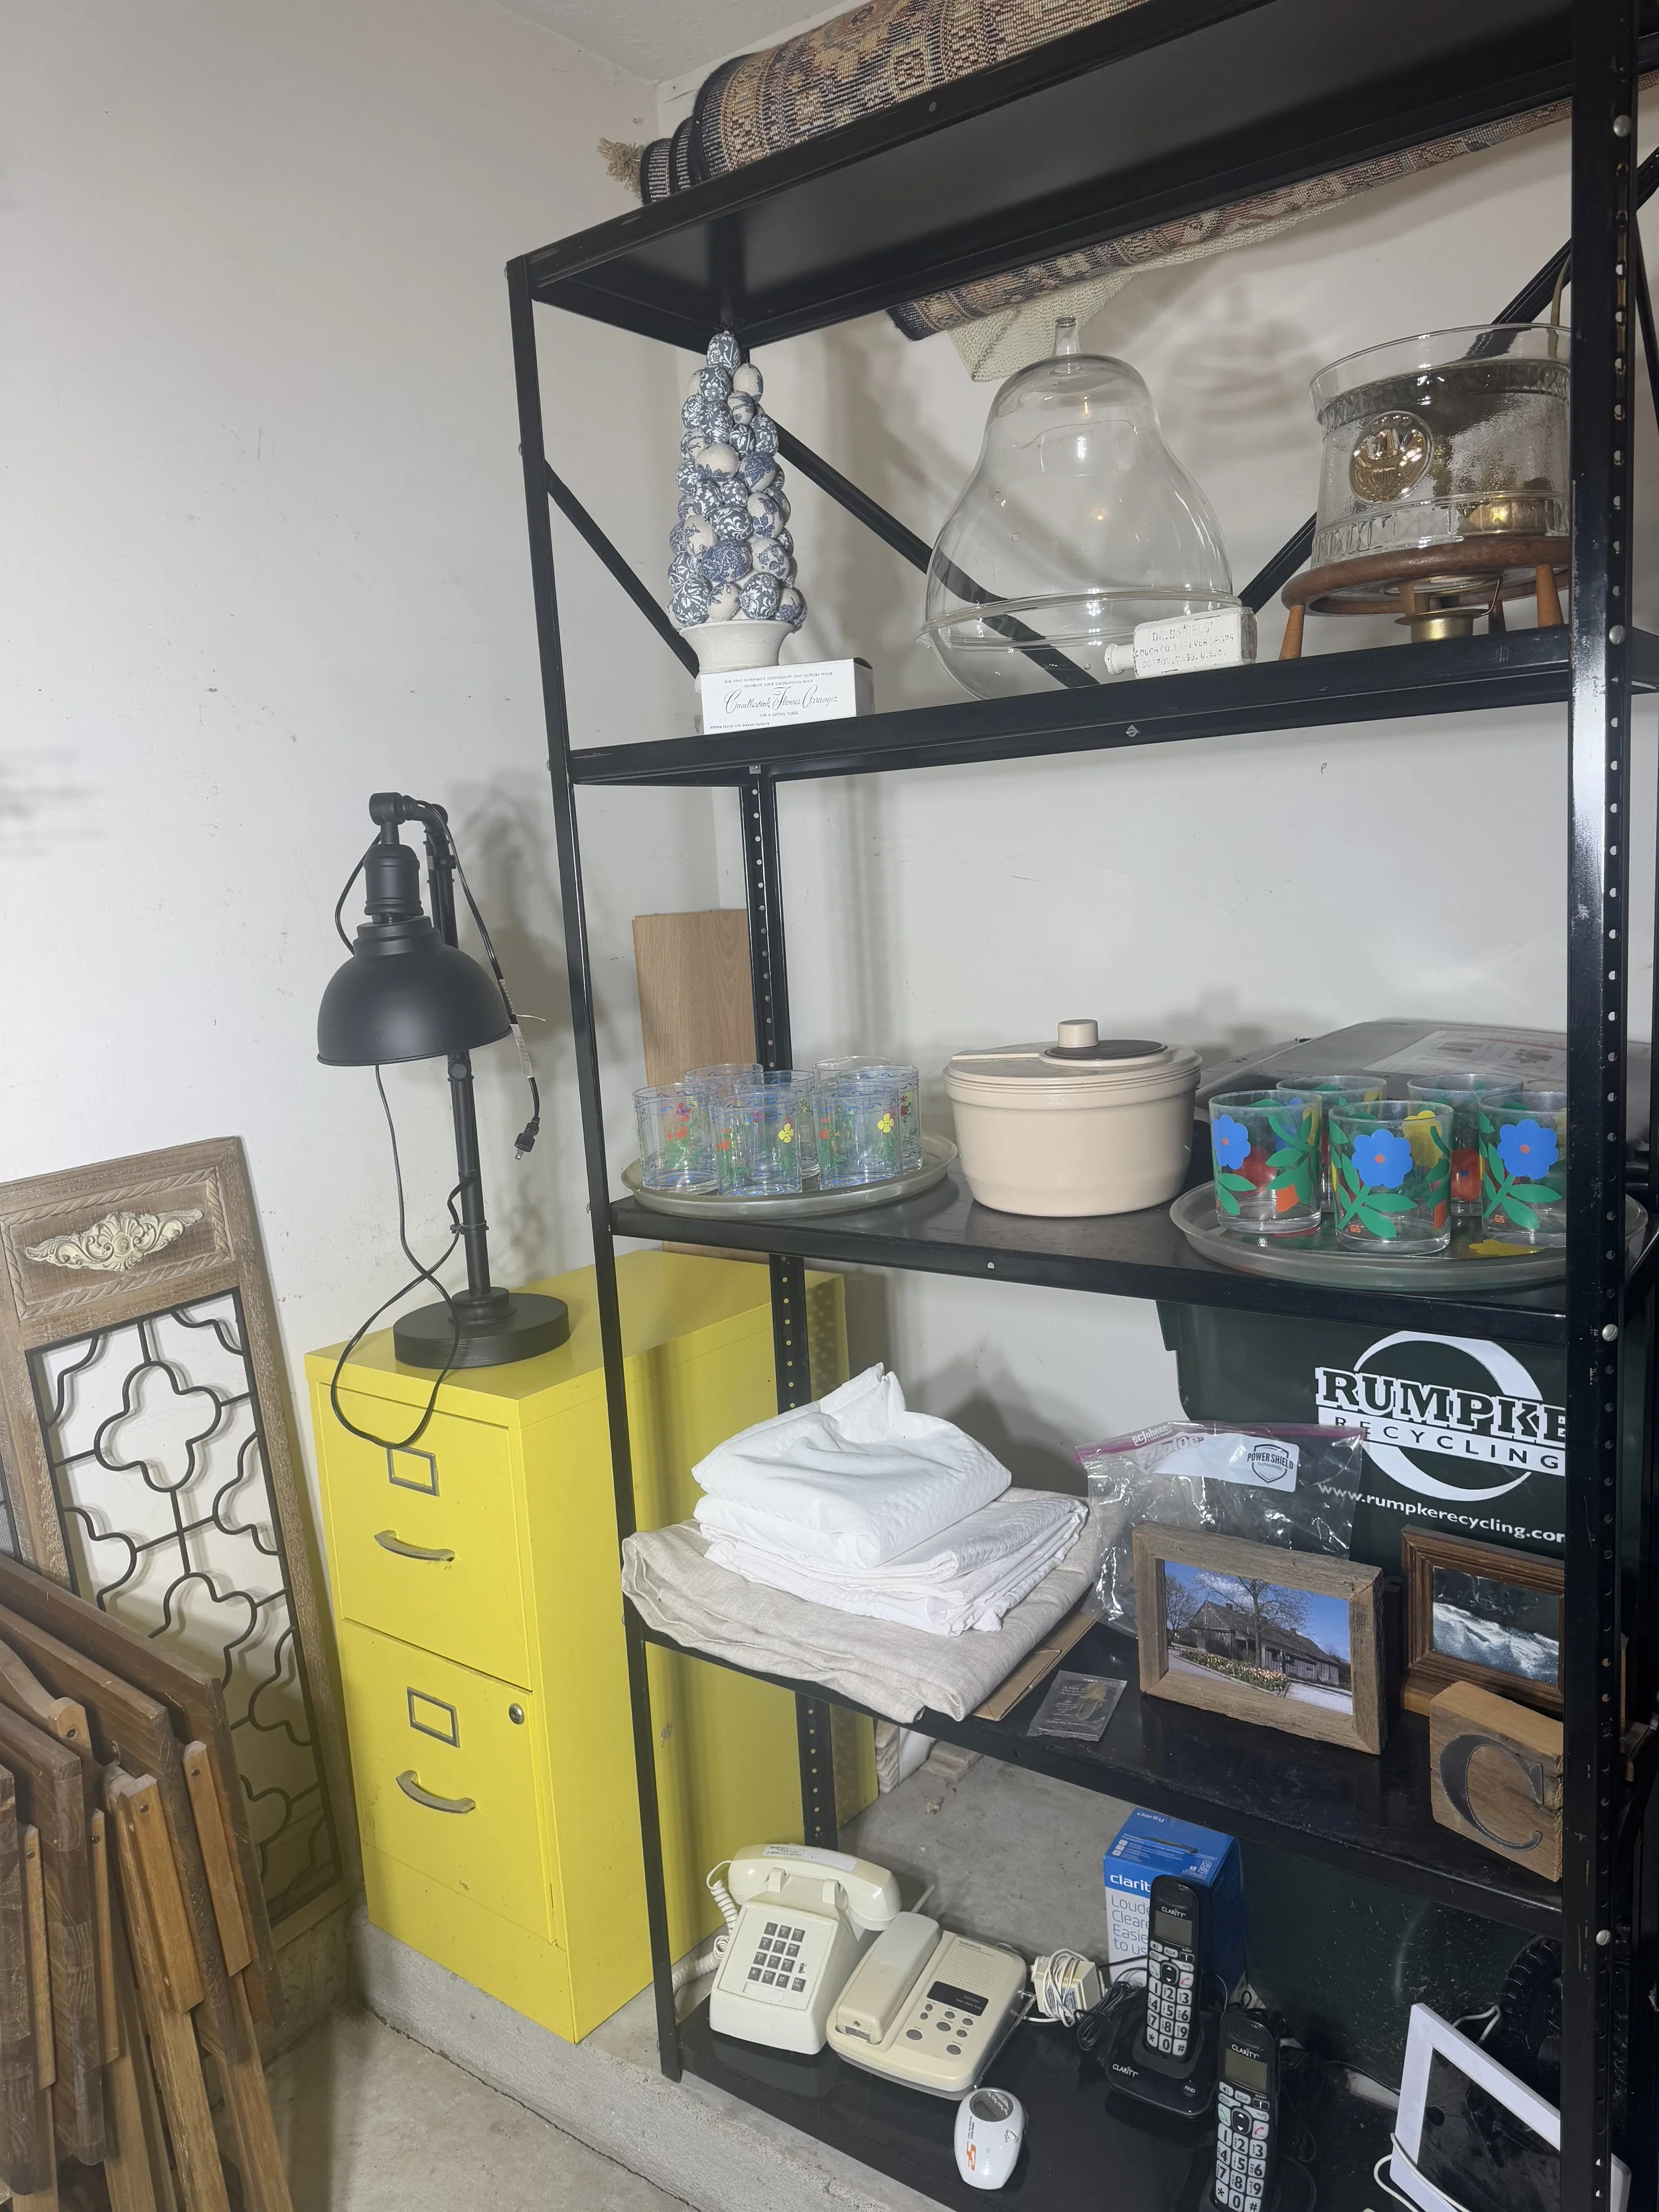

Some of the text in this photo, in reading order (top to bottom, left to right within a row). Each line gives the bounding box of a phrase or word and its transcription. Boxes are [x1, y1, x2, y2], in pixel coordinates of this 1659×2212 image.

[724, 684, 837, 713] Candlestick Flower Arranger
[1315, 1366, 1566, 1447] RUMPKE
[1334, 1415, 1559, 1469] RECYCLING
[1247, 1452, 1293, 1469] POWER SHIELD
[1257, 1462, 1282, 1471] Technology
[1137, 1811, 1165, 1823] clarity
[1110, 1874, 1151, 1893] clarit
[1113, 1923, 1149, 1945] Easie
[1114, 1937, 1148, 1955] to us
[1167, 1987, 1173, 2000] 2
[1181, 1992, 1189, 2004] 3
[1151, 2000, 1158, 2011] 4
[1166, 2005, 1173, 2016] 5
[1151, 2014, 1157, 2026] 7
[1181, 2010, 1189, 2021] 6
[1165, 2021, 1171, 2033] 8
[1181, 2026, 1188, 2037] 9
[1163, 2039, 1170, 2051] 0
[1185, 2085, 1195, 2093] FIND
[1237, 2138, 1245, 2152] 2
[1256, 2144, 1263, 2157] 3
[1220, 2150, 1227, 2162] 4
[1237, 2158, 1245, 2170] 5
[1254, 2164, 1262, 2176] 6
[1220, 2166, 1226, 2179] 7
[1234, 2175, 1242, 2189] 8
[1254, 2182, 1262, 2195] 9
[1232, 2195, 1241, 2209] 0
